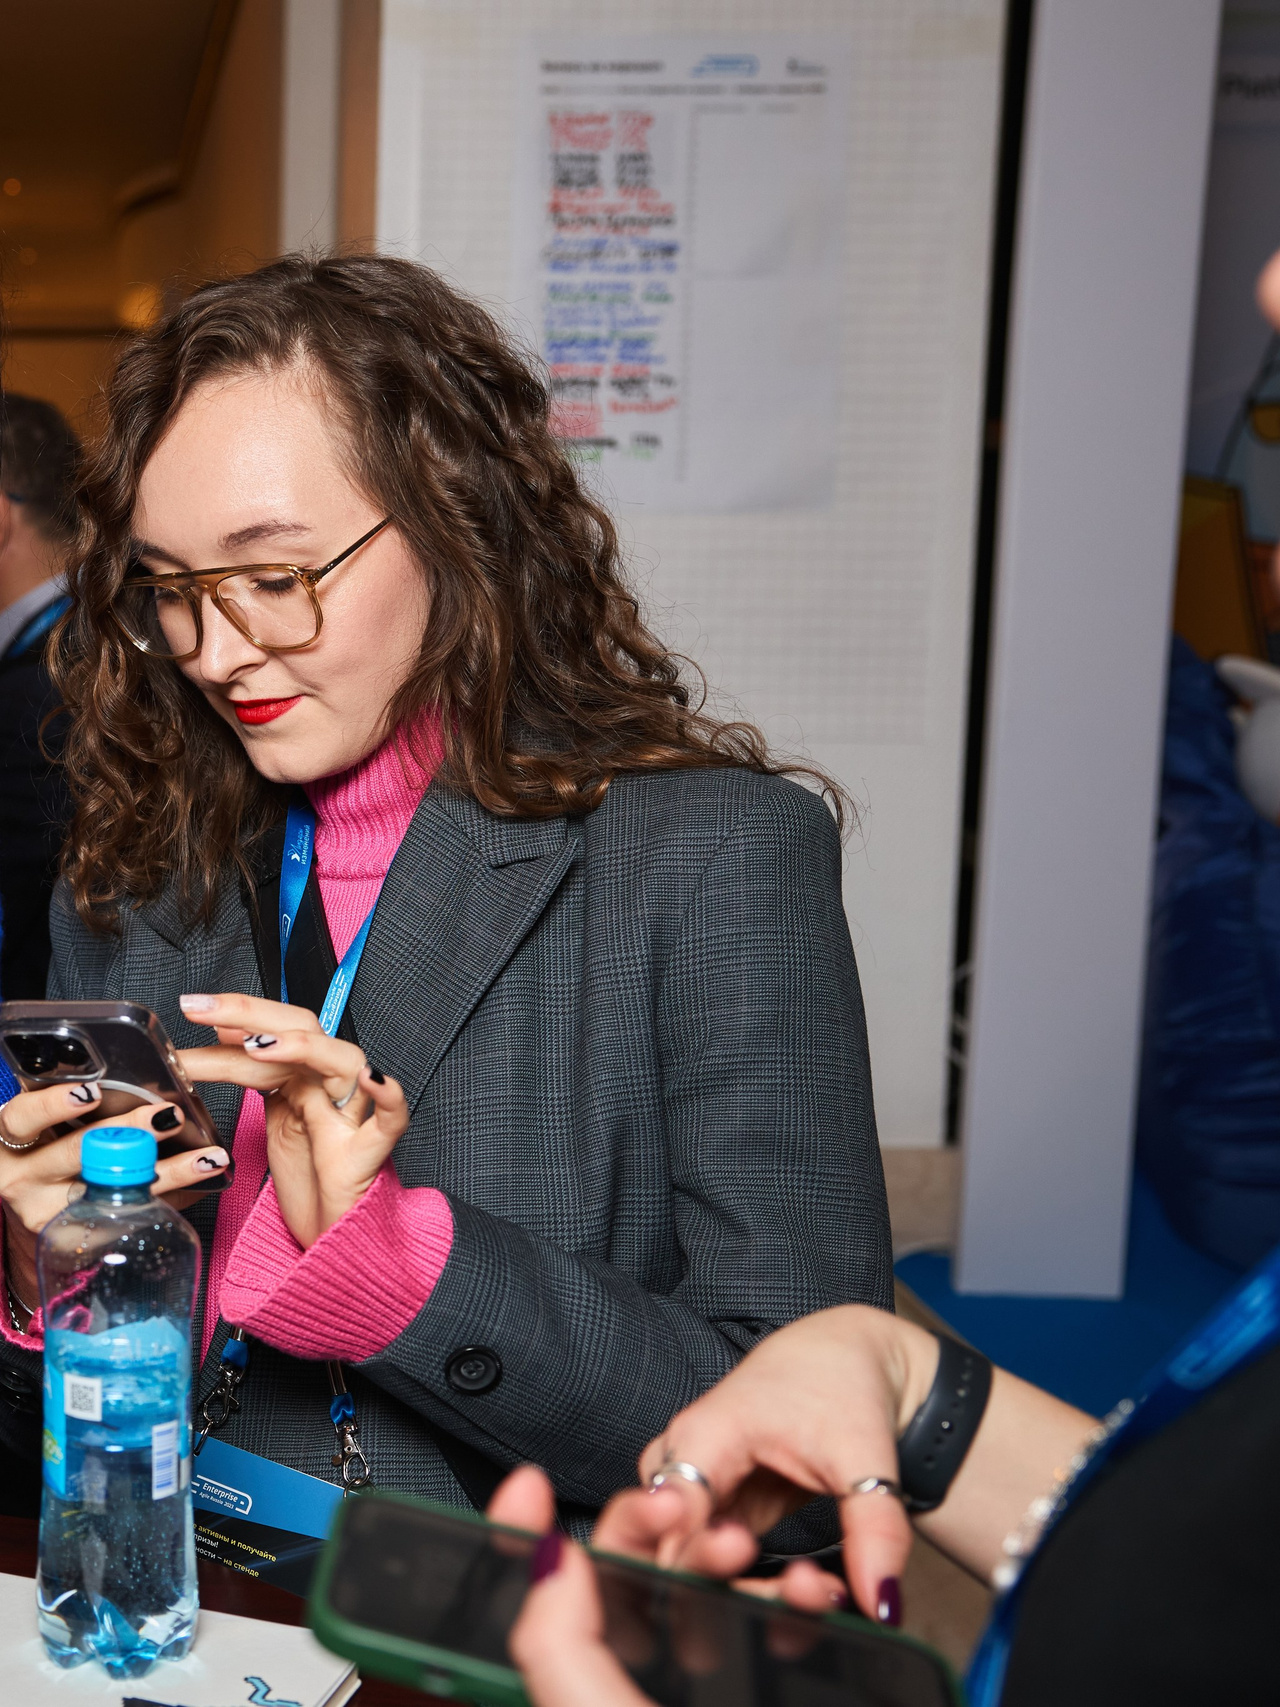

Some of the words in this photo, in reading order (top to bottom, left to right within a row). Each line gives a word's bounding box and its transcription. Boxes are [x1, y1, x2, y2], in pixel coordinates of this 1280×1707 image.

[328, 987, 342, 1021] Enterprise
[199, 1491, 210, 1500] Agile
[210, 1495, 224, 1505] Russia
[223, 1501, 234, 1510] 2023
[202, 1482, 239, 1503] Enterprise
[198, 1525, 230, 1543] активны
[237, 1541, 277, 1563] получайте
[223, 1558, 233, 1567] на
[233, 1562, 260, 1578] стенде
